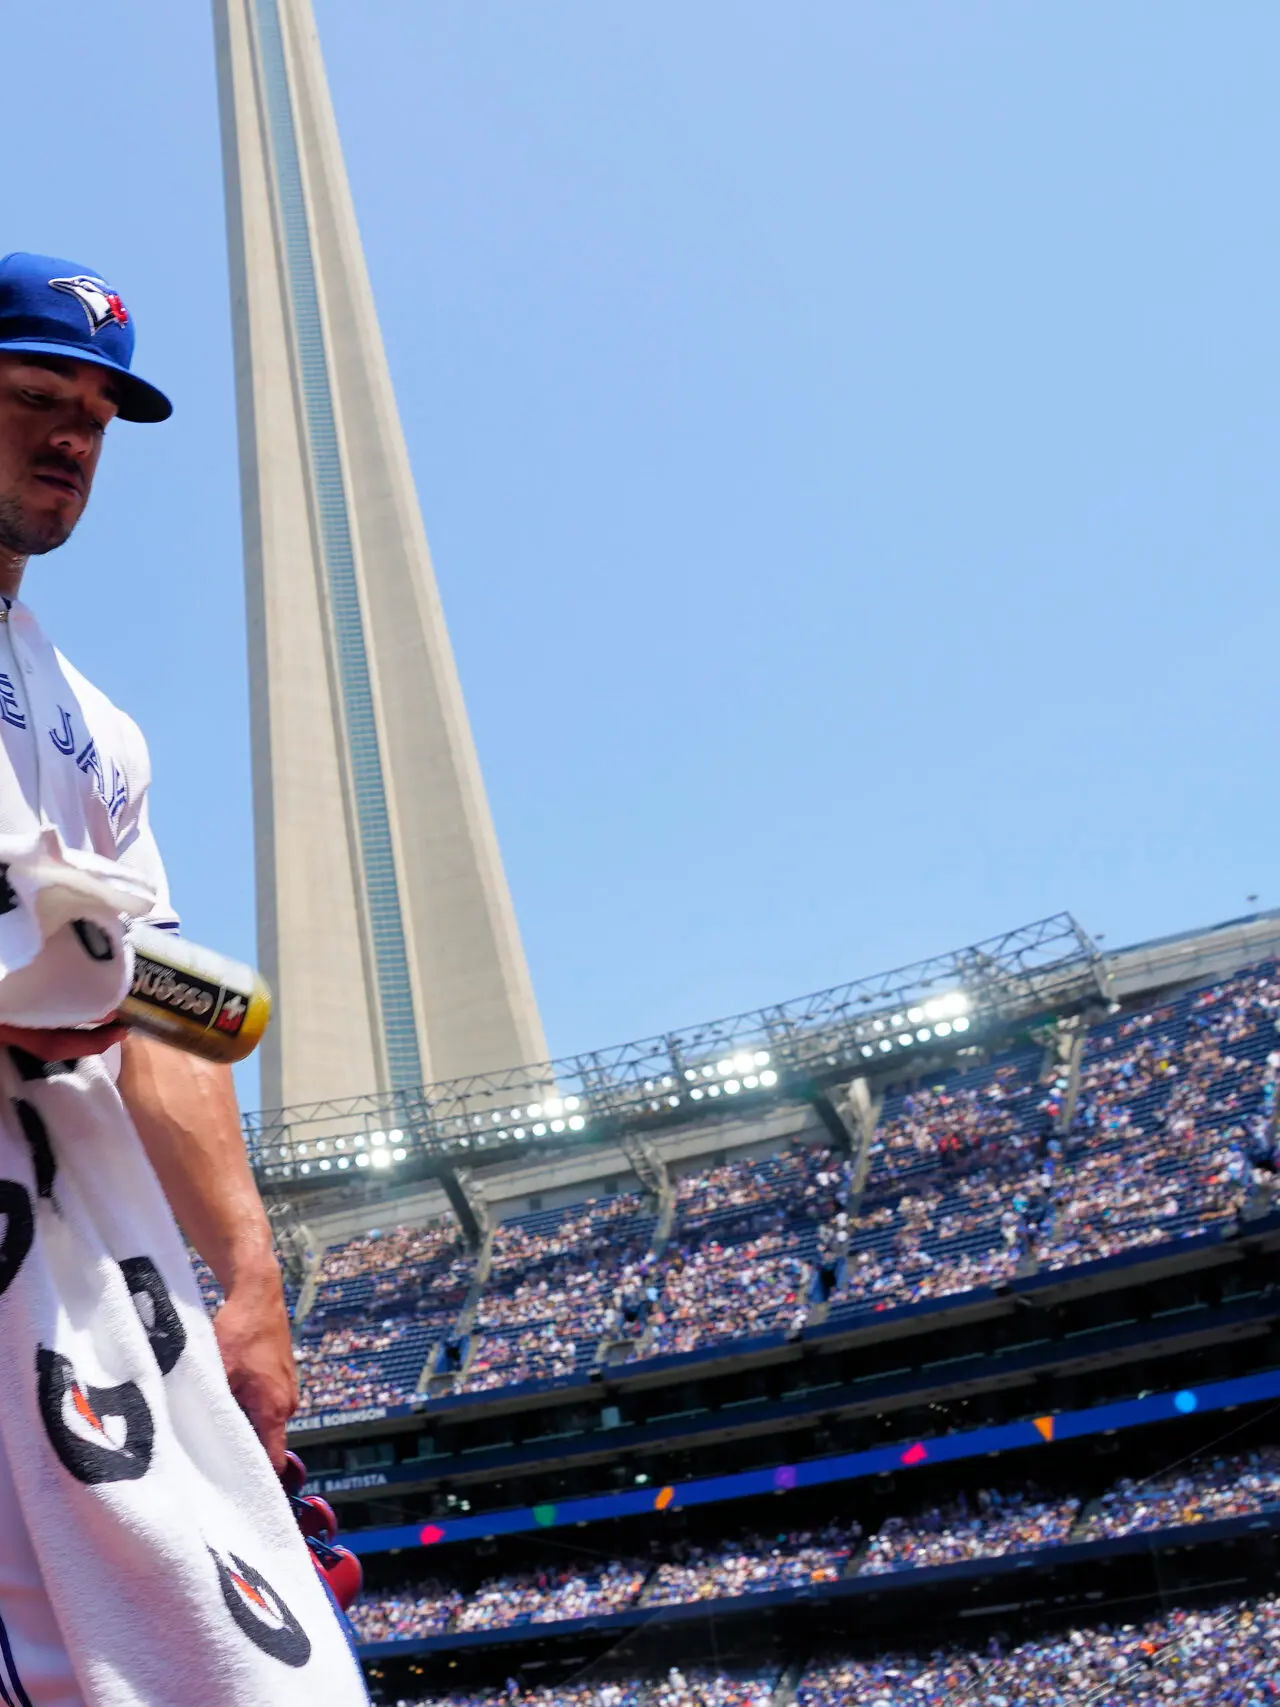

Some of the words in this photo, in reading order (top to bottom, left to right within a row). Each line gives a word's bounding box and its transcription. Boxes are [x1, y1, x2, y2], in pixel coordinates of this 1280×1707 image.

[48, 703, 128, 823] JAY
[284, 1415, 321, 1433] ACKIE
[325, 1473, 388, 1493] BAUTISTA
